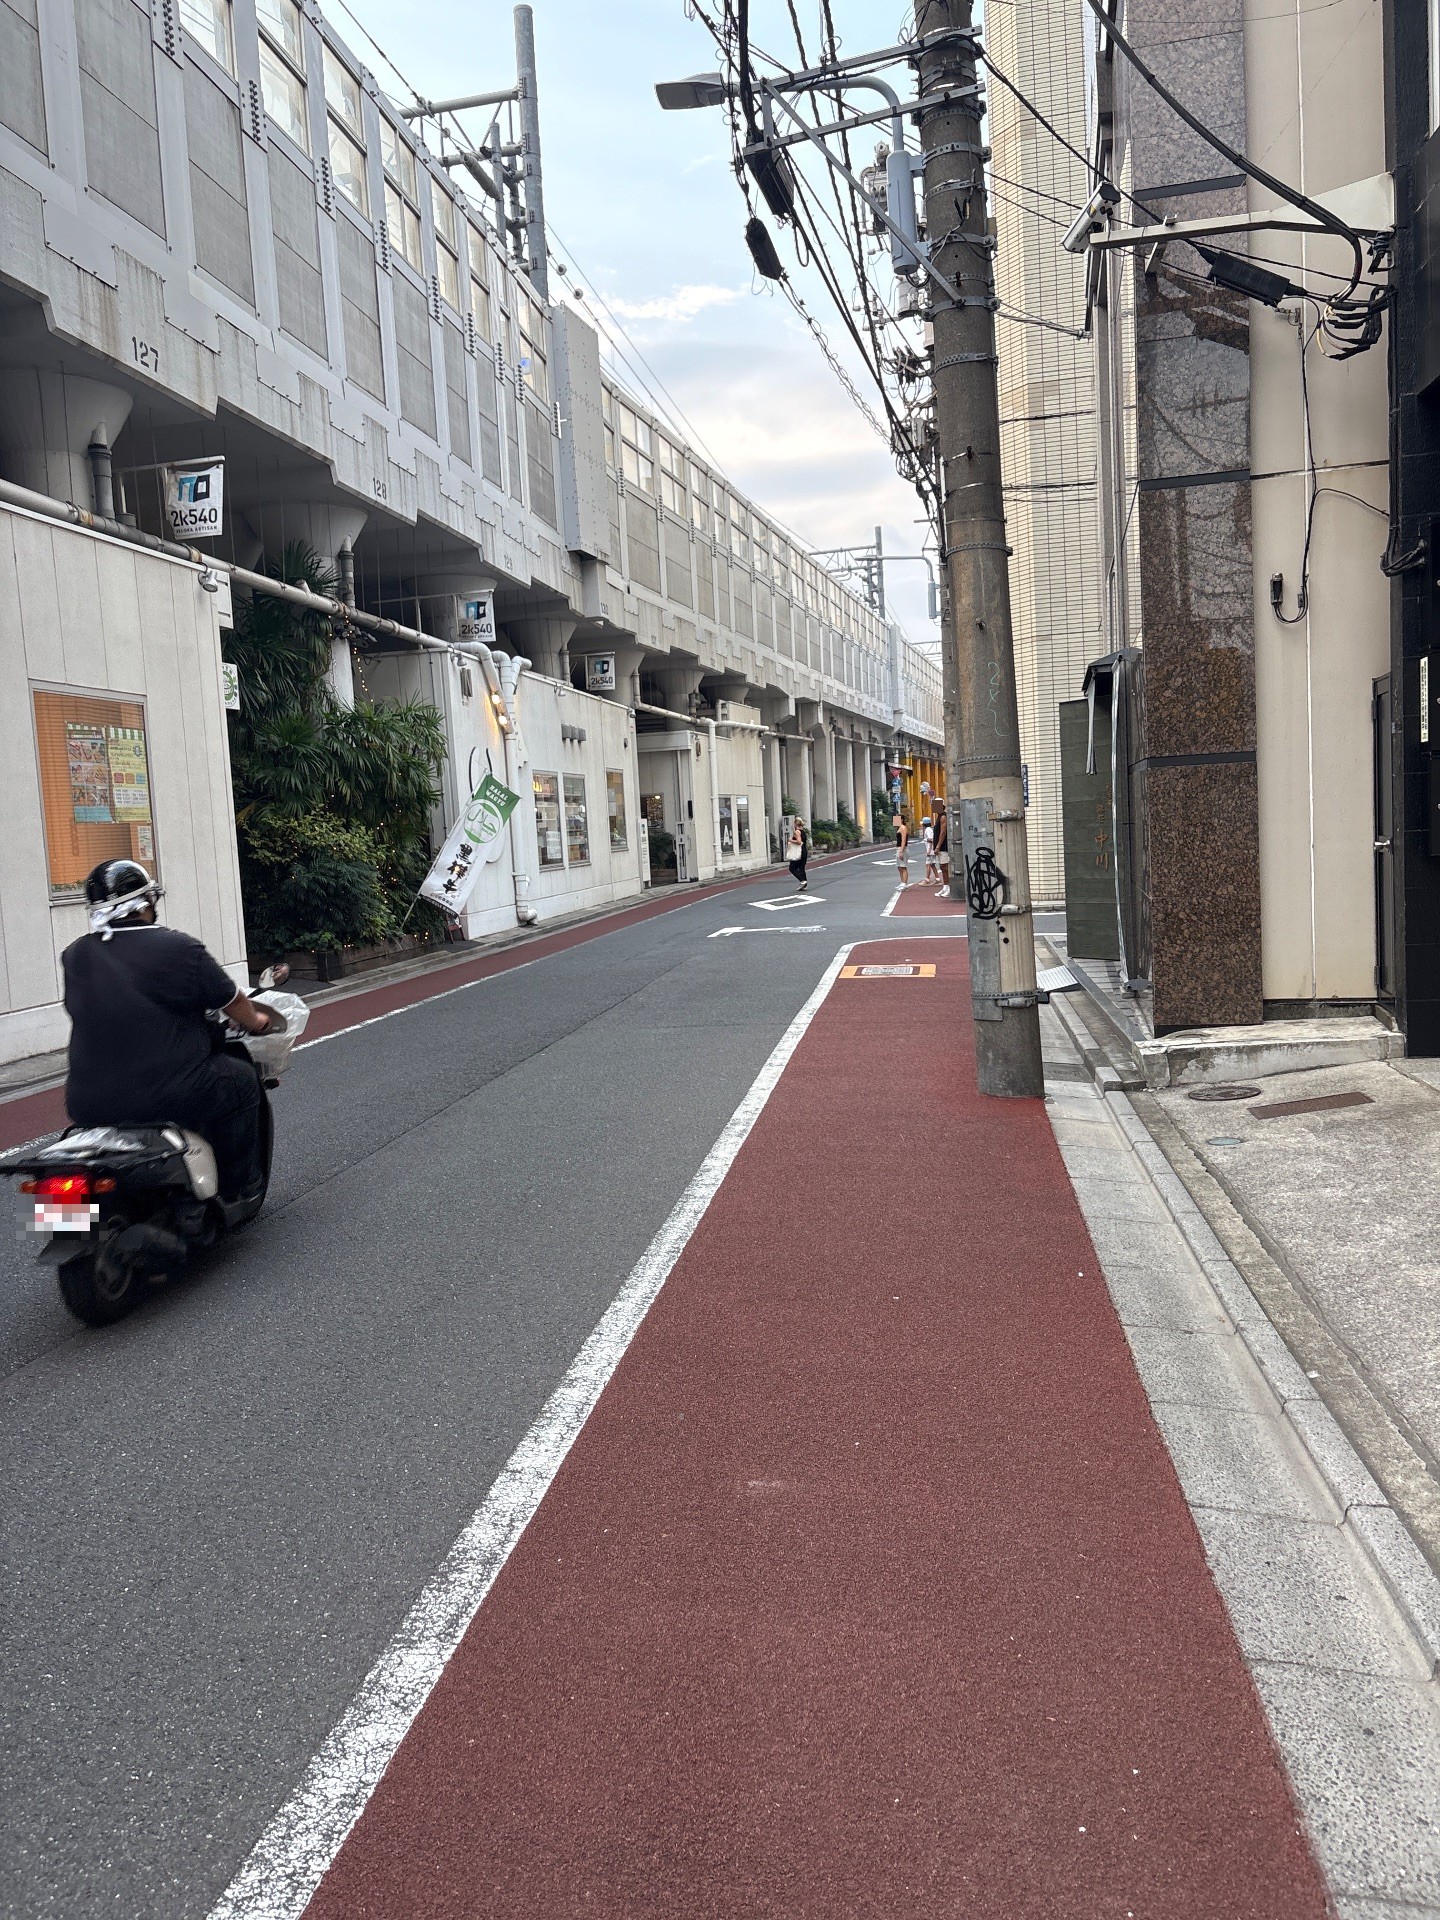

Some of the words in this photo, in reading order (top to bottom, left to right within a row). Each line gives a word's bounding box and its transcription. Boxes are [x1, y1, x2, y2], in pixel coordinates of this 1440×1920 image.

[131, 335, 159, 373] 127
[170, 508, 218, 527] 2k540
[461, 623, 493, 635] 2k540
[590, 676, 614, 685] 2k540
[489, 785, 508, 801] HALAL
